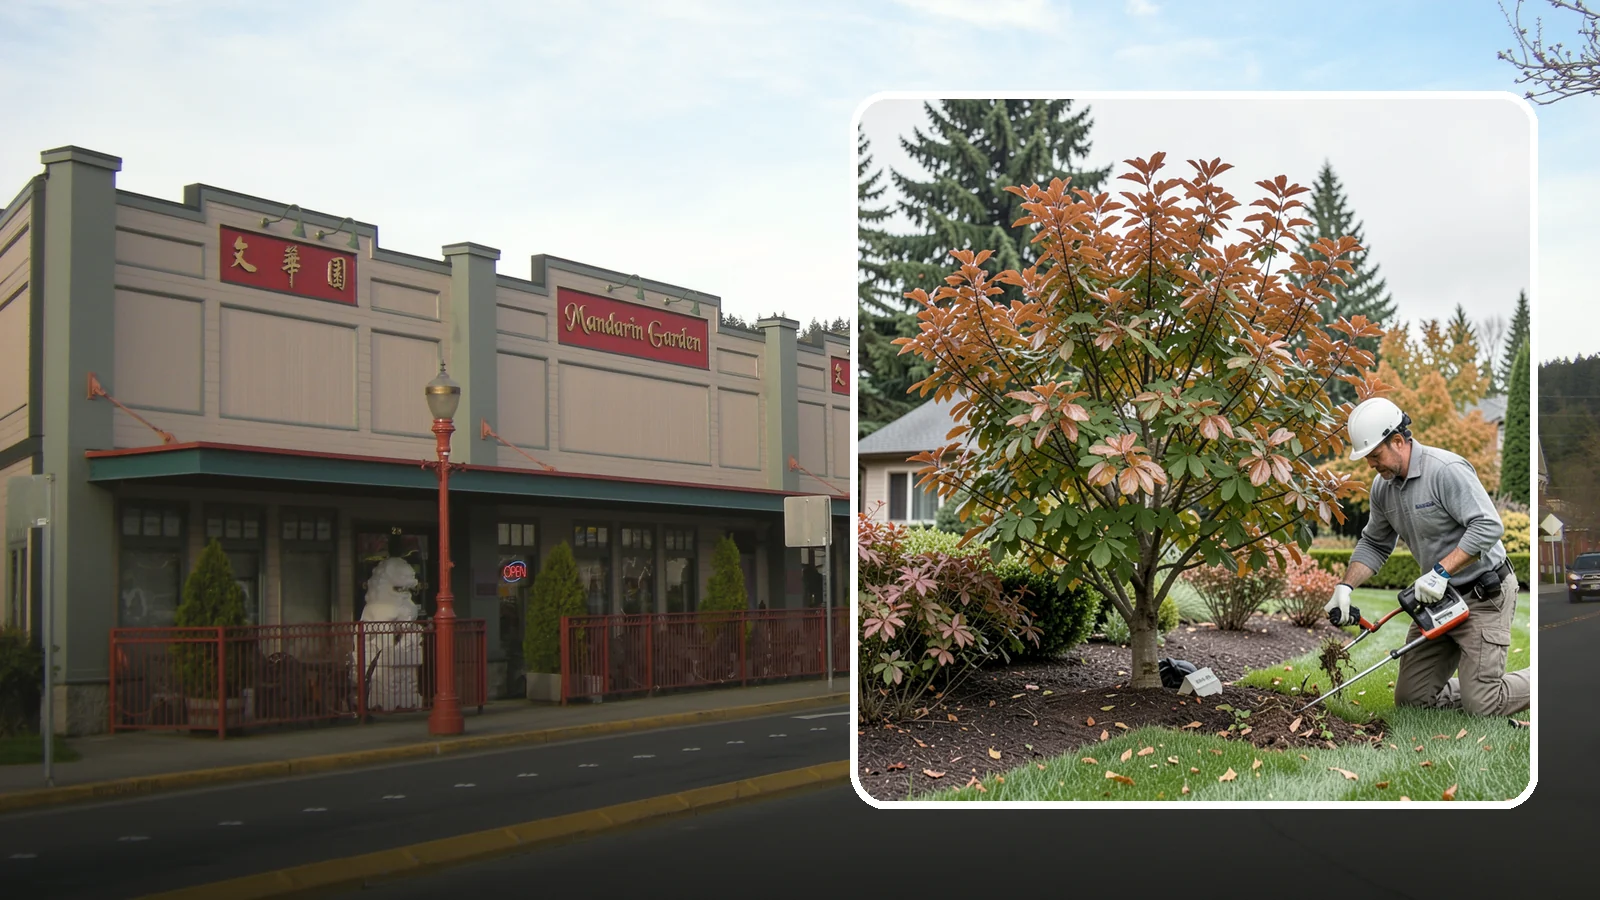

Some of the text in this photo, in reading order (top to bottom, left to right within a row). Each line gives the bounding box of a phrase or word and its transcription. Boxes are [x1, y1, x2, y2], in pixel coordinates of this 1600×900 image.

[231, 236, 346, 291] 文華園
[565, 302, 701, 352] Mandarin Garden
[835, 363, 846, 387] 文
[503, 565, 527, 578] OPEN
